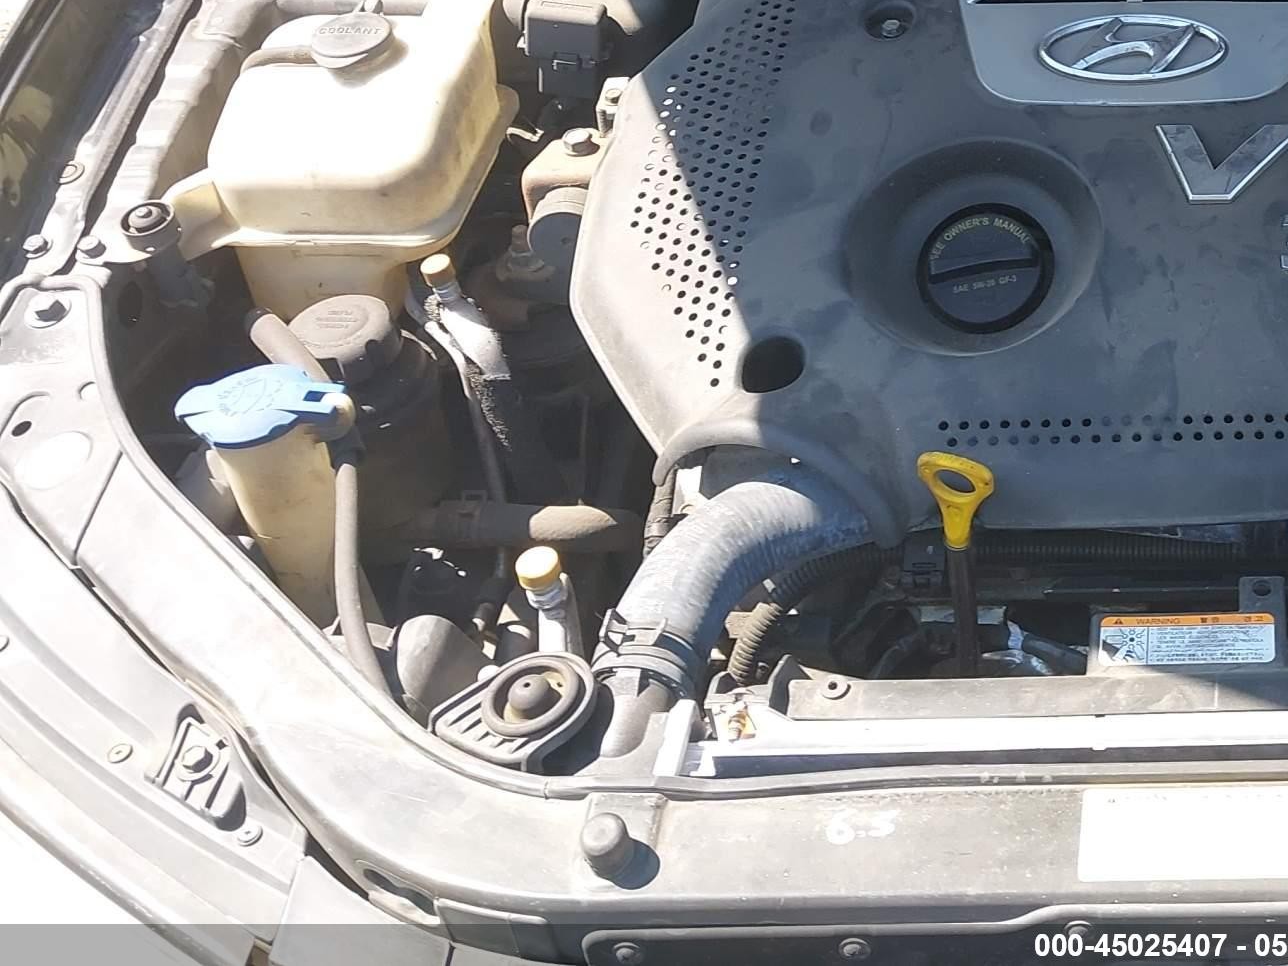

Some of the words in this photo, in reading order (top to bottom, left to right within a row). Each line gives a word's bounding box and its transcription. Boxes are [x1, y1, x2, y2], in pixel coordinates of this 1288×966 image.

[319, 25, 384, 35] COOLANT
[943, 217, 989, 241] OWNER'S
[993, 217, 1031, 244] MANUAL
[1136, 617, 1181, 625] WARNING
